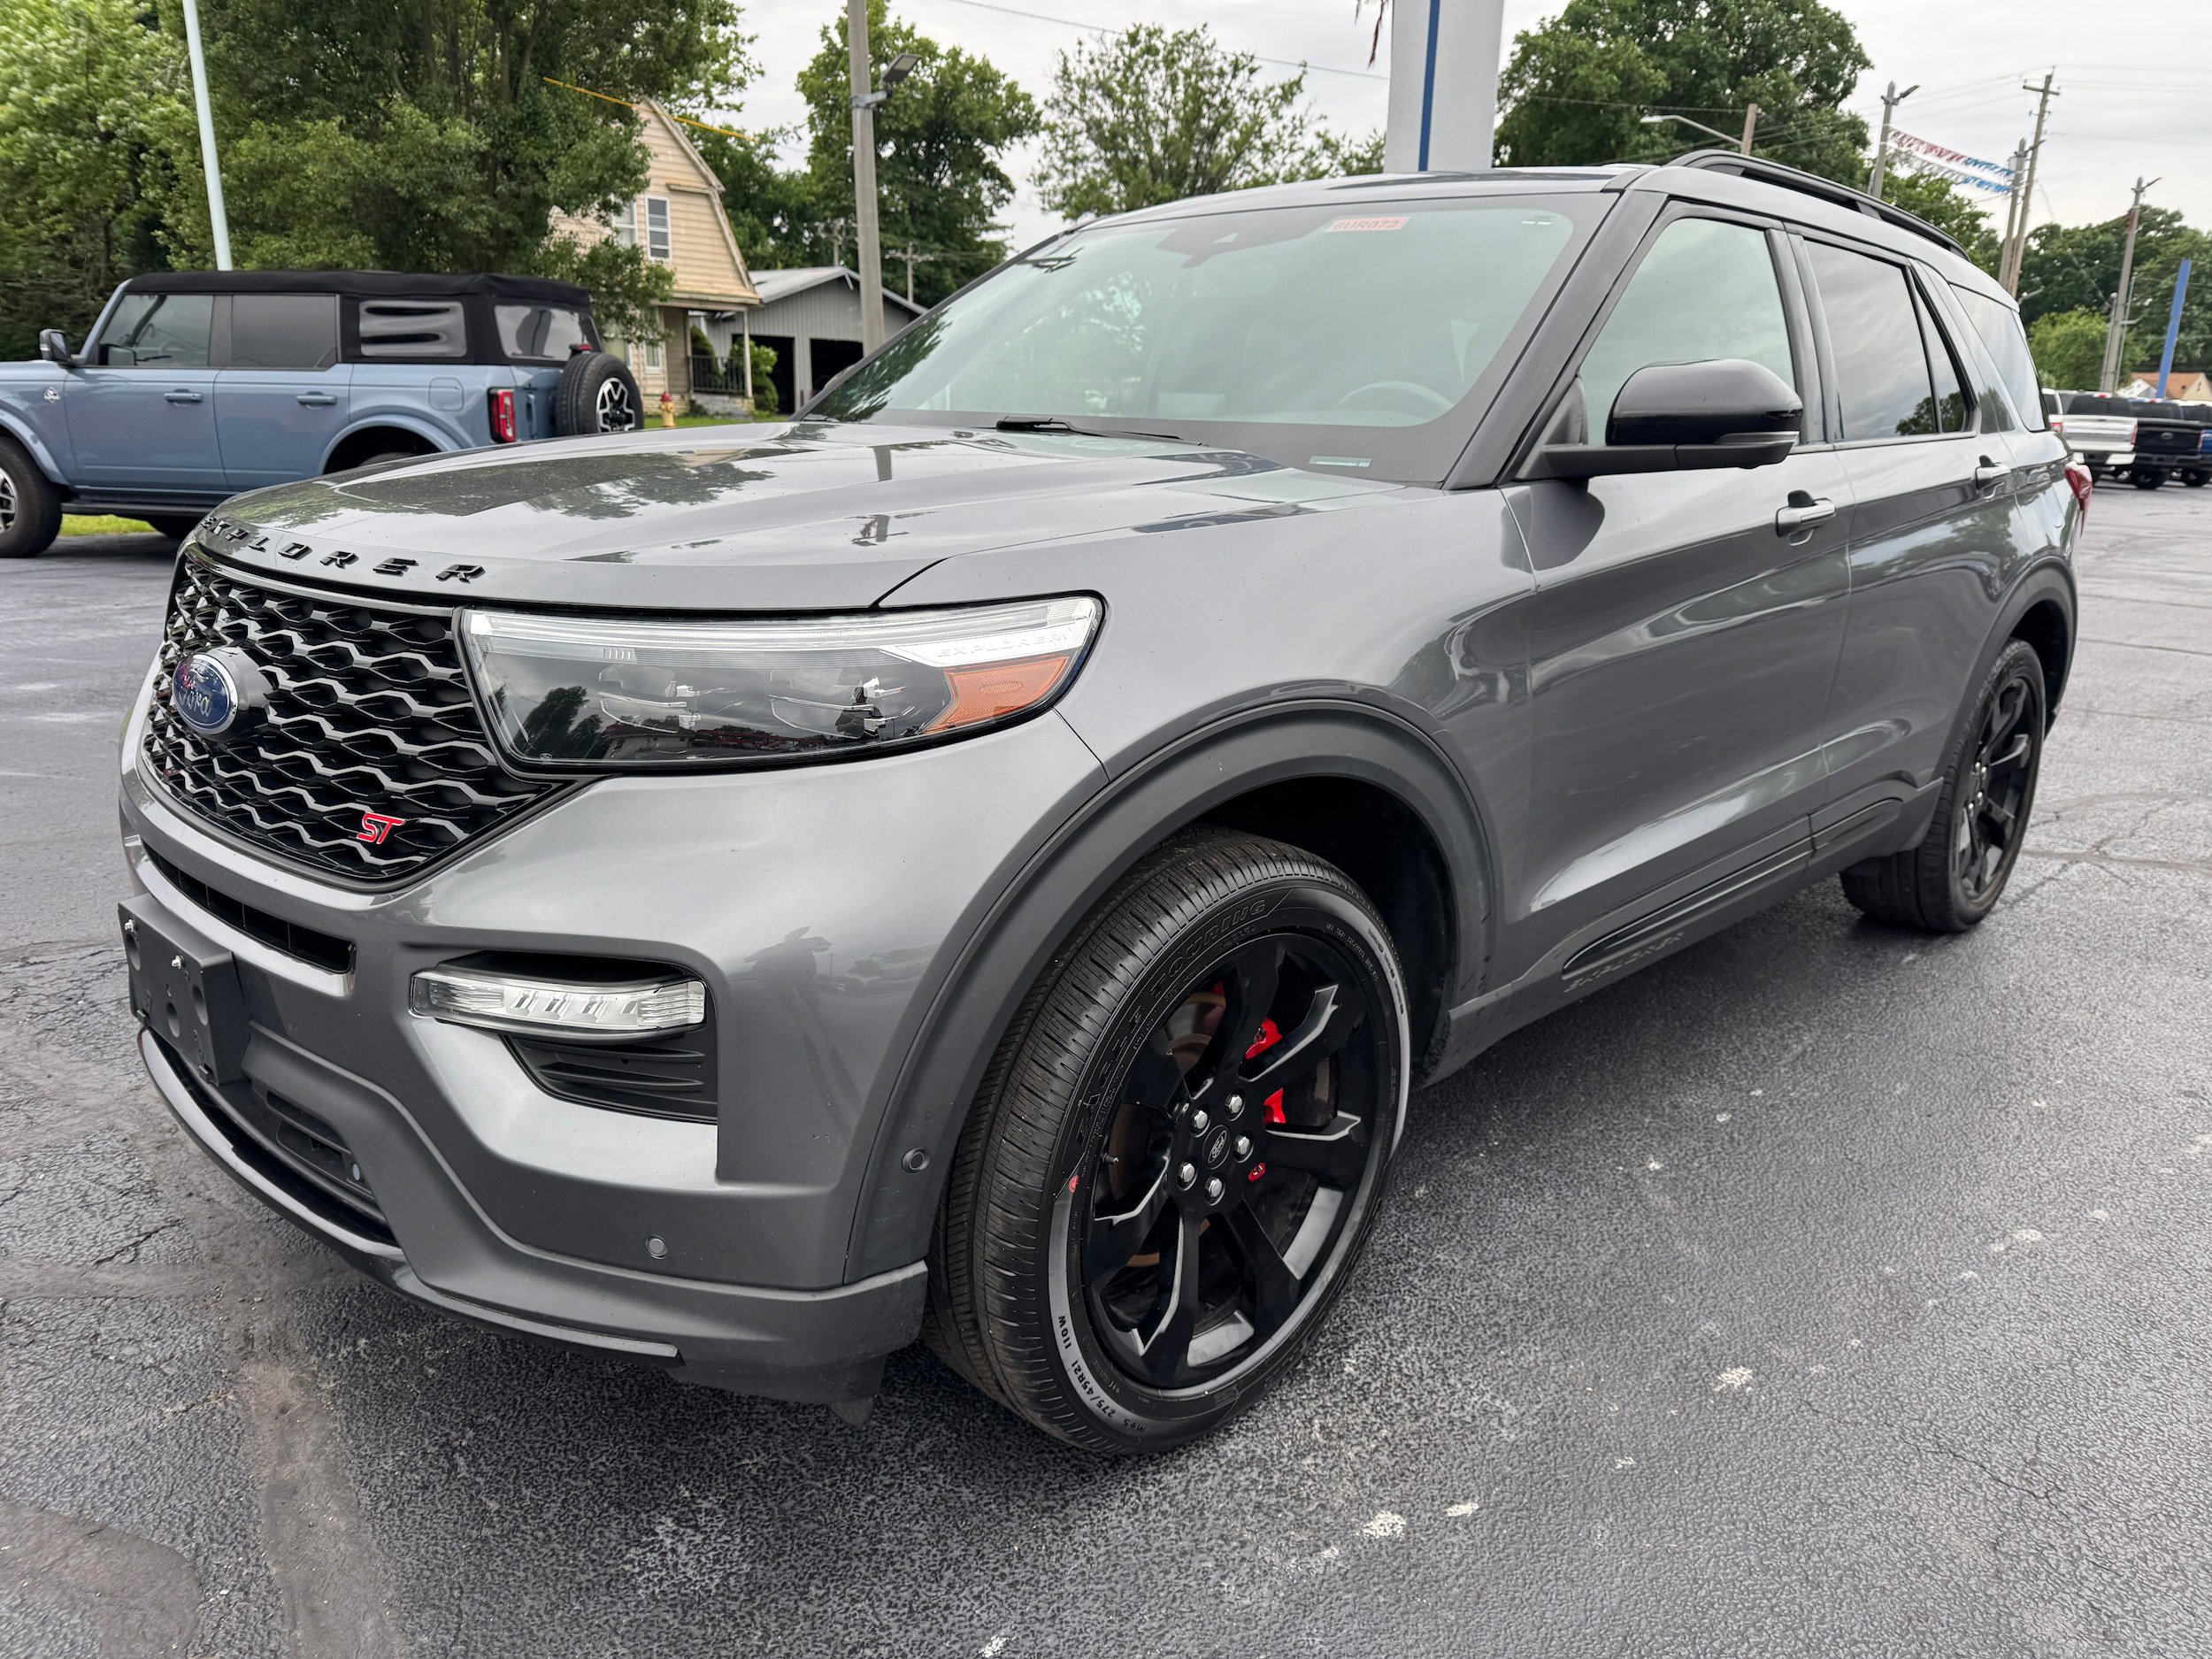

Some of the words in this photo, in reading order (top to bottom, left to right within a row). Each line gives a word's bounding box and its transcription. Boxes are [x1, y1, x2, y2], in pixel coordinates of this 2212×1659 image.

[200, 516, 487, 583] EXPLORER
[937, 633, 1068, 657] EXPLORER
[178, 667, 212, 718] Ford
[356, 812, 407, 845] ST
[1150, 899, 1266, 999] TOURING
[1071, 1359, 1117, 1417] 275/45R21
